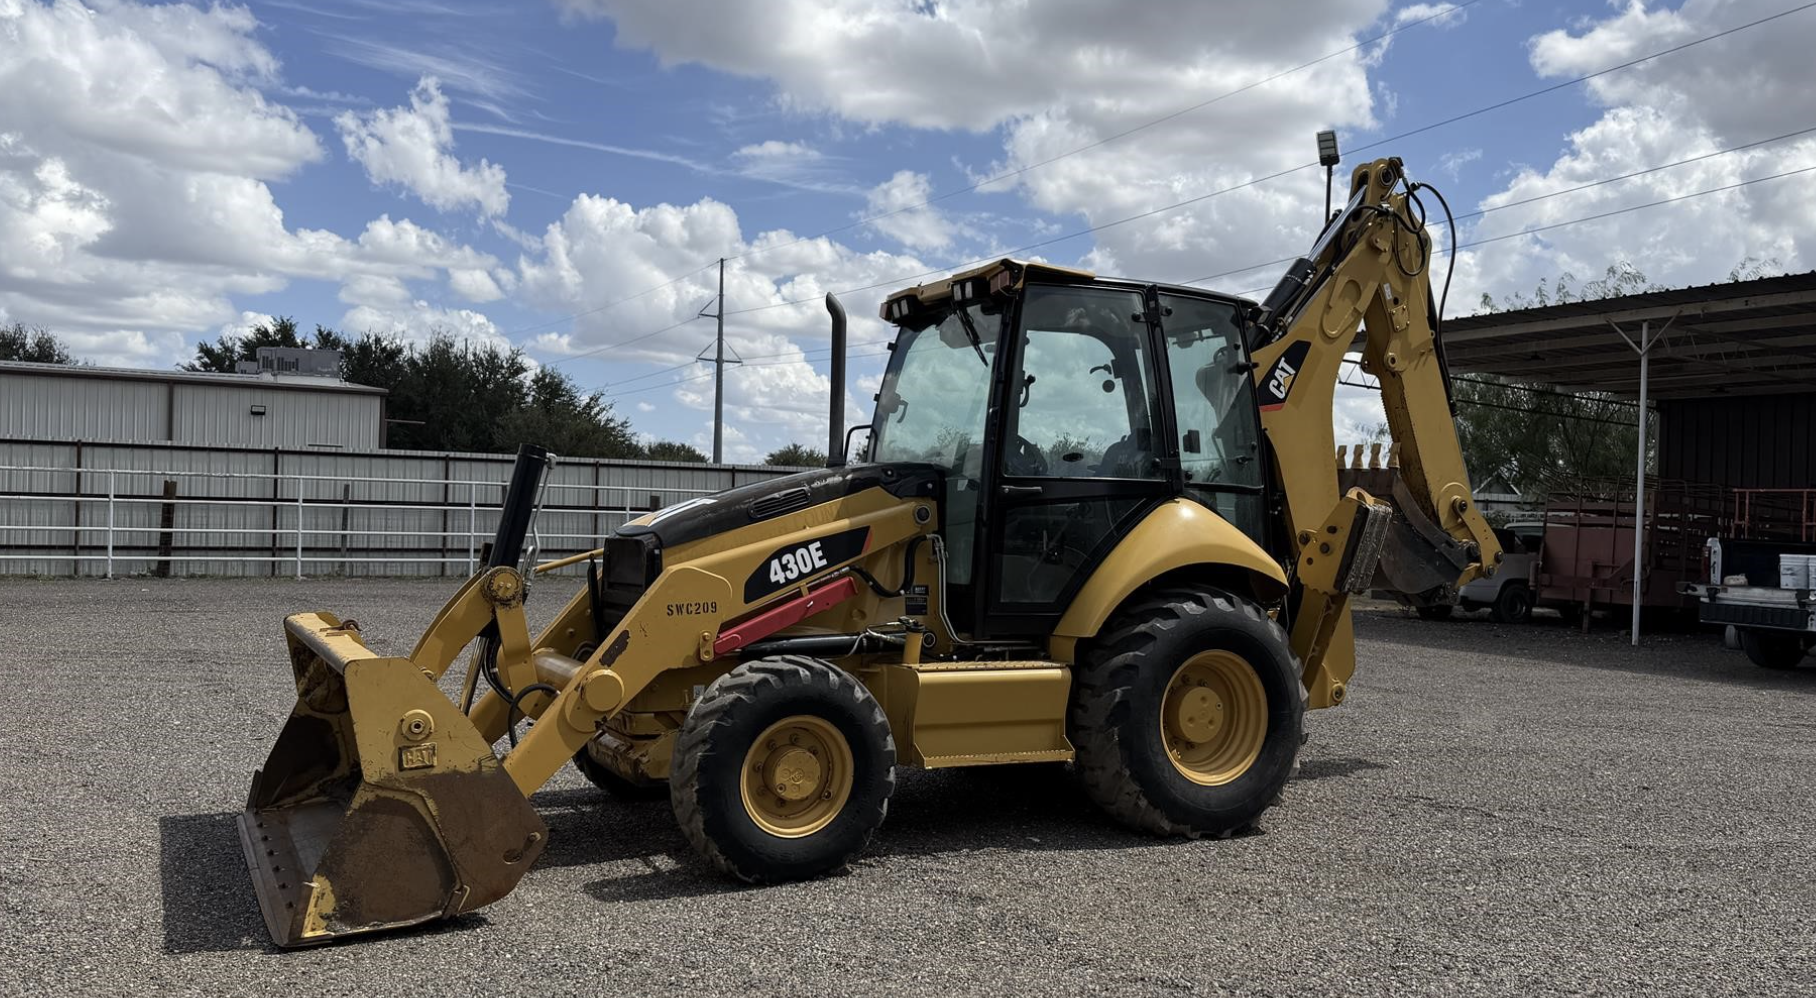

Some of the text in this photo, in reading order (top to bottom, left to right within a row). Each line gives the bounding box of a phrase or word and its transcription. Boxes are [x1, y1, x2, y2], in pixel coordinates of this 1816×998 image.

[1269, 356, 1296, 399] CAT
[769, 540, 828, 584] 430E
[667, 601, 717, 617] SWC209
